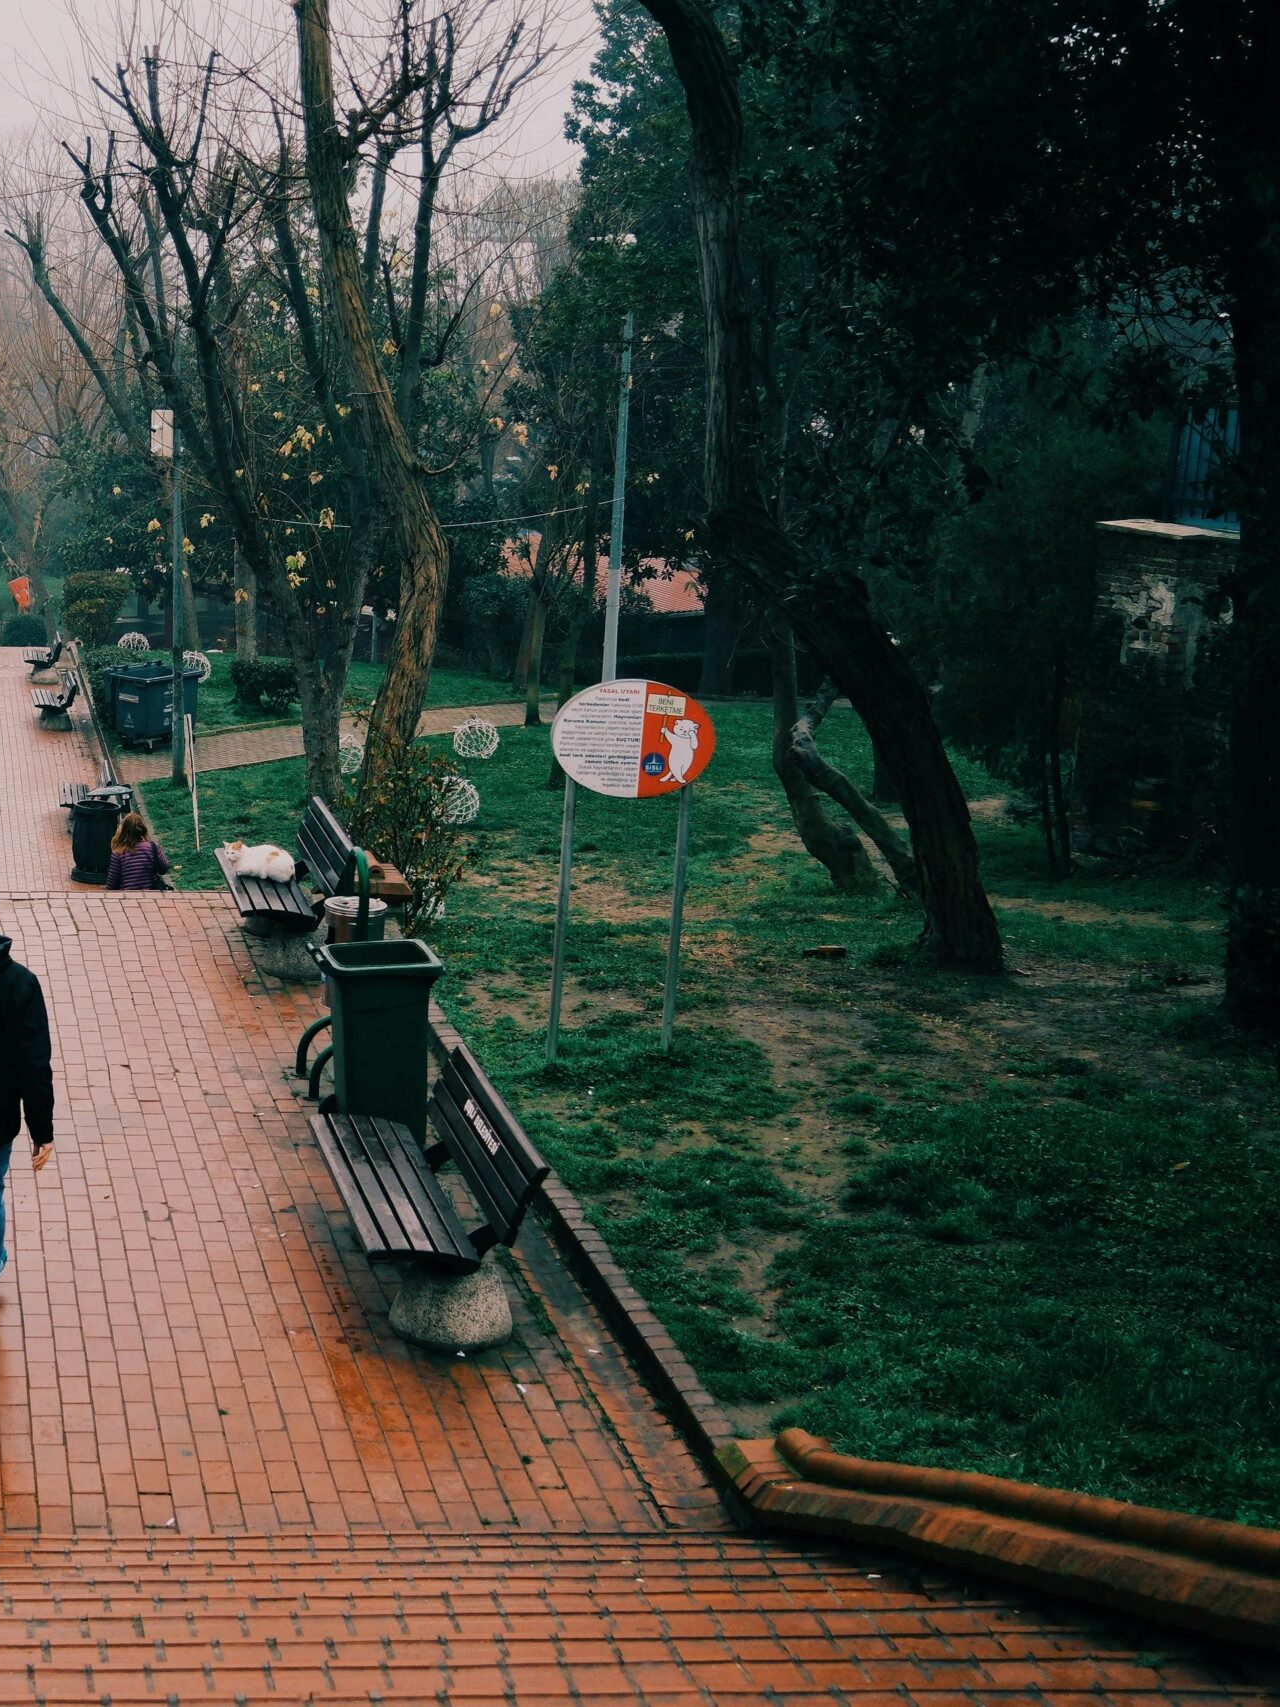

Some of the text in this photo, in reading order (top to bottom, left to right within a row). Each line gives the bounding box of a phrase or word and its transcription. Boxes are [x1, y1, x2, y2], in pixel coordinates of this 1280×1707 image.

[657, 697, 674, 706] BENİ
[648, 704, 684, 715] TERKETME
[473, 1114, 501, 1156] BELEDİYESİ
